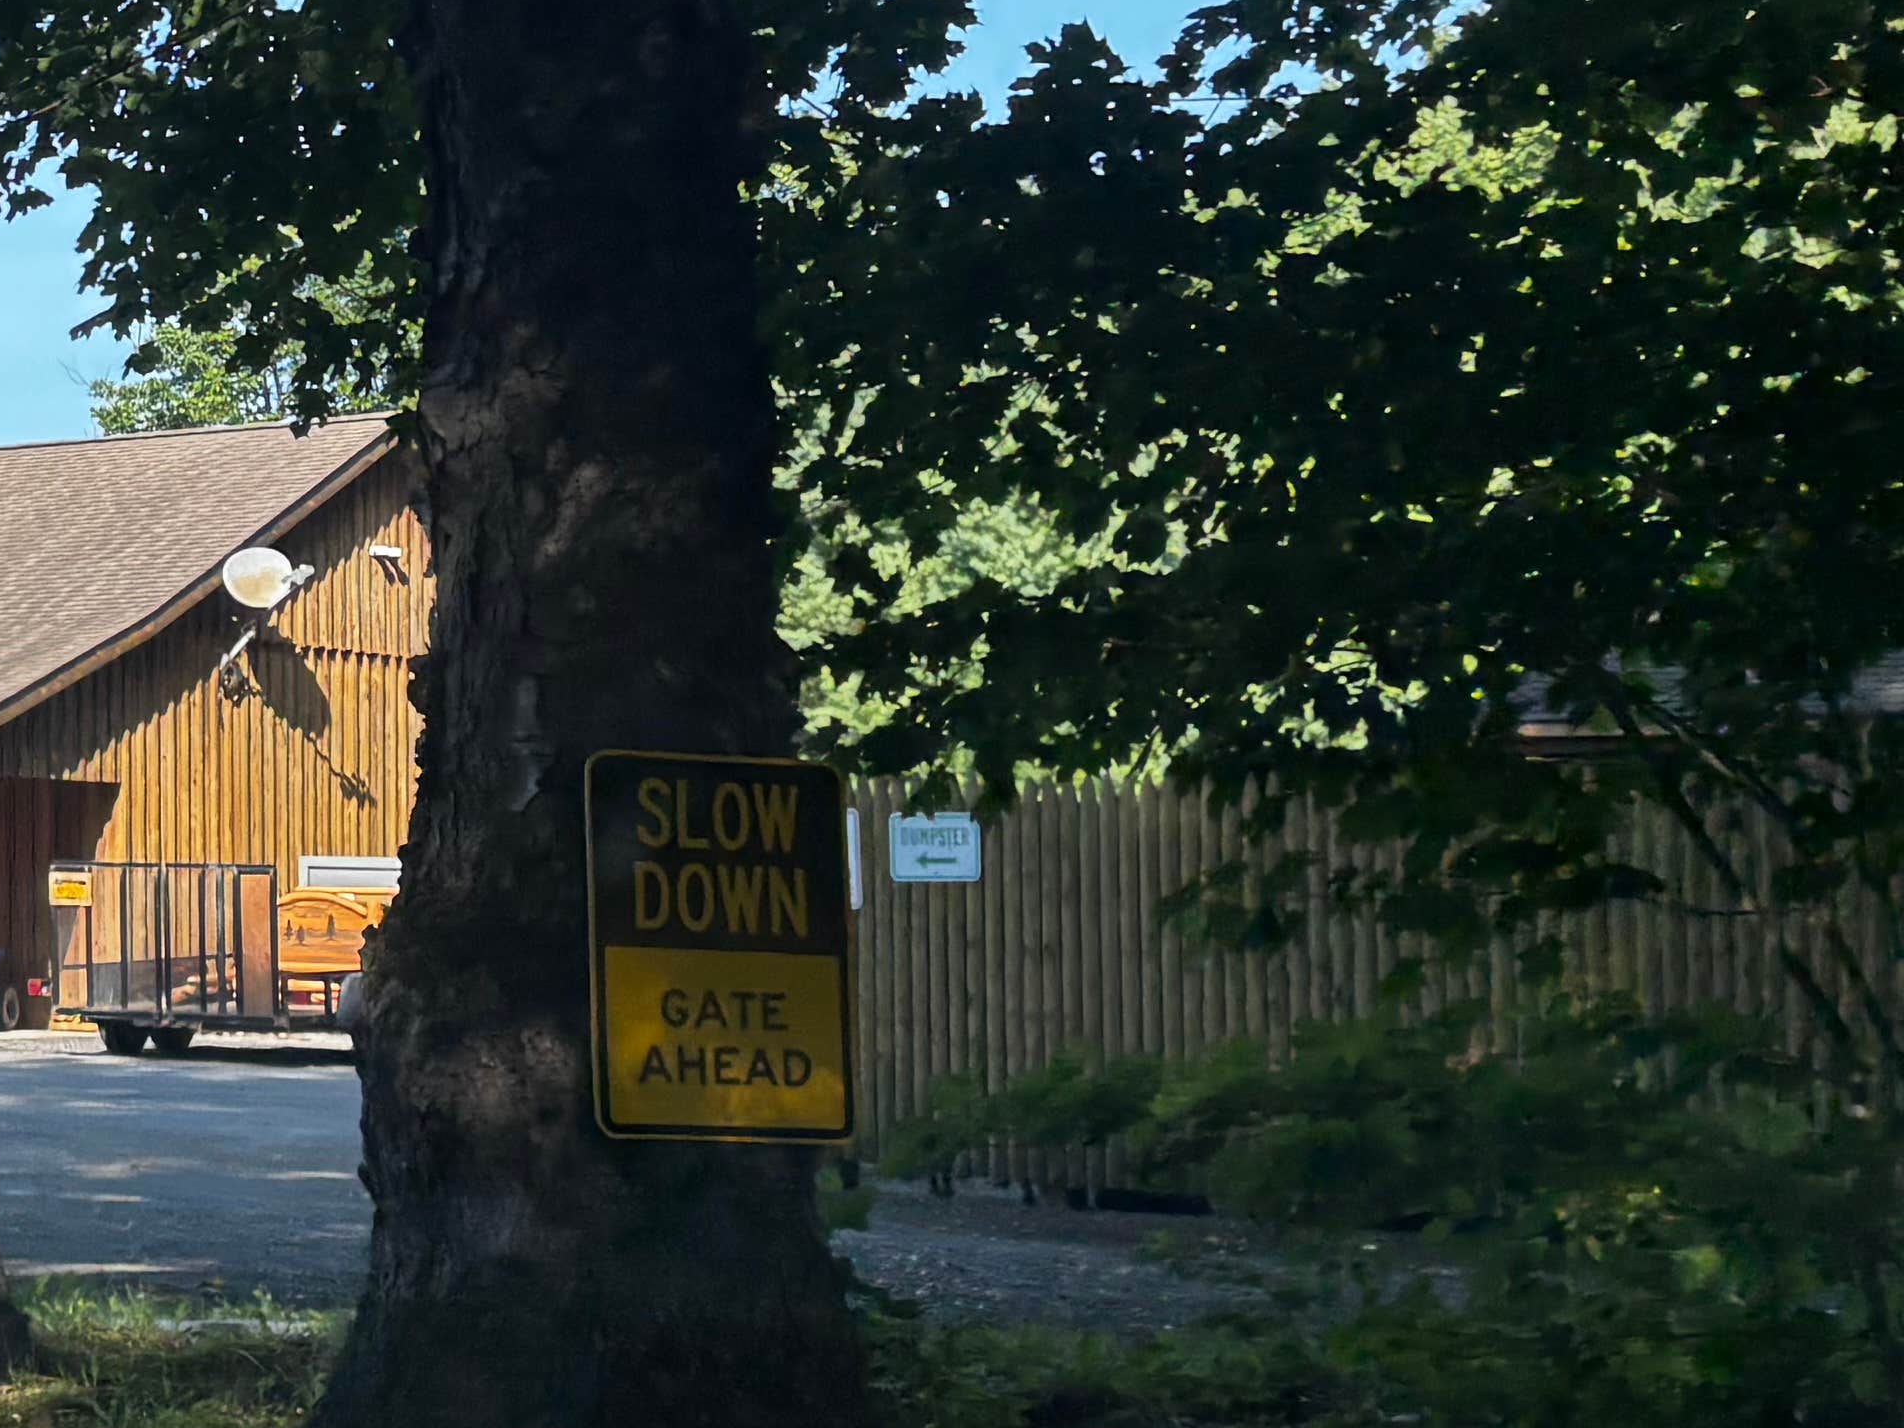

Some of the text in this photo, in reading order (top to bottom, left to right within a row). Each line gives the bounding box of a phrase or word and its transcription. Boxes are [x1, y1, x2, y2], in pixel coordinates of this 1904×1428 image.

[637, 778, 798, 853] SLOW
[900, 826, 970, 847] DUMPSTER
[633, 861, 808, 936] DOWN
[661, 988, 789, 1032] GATE
[638, 1046, 813, 1088] AHEAD
